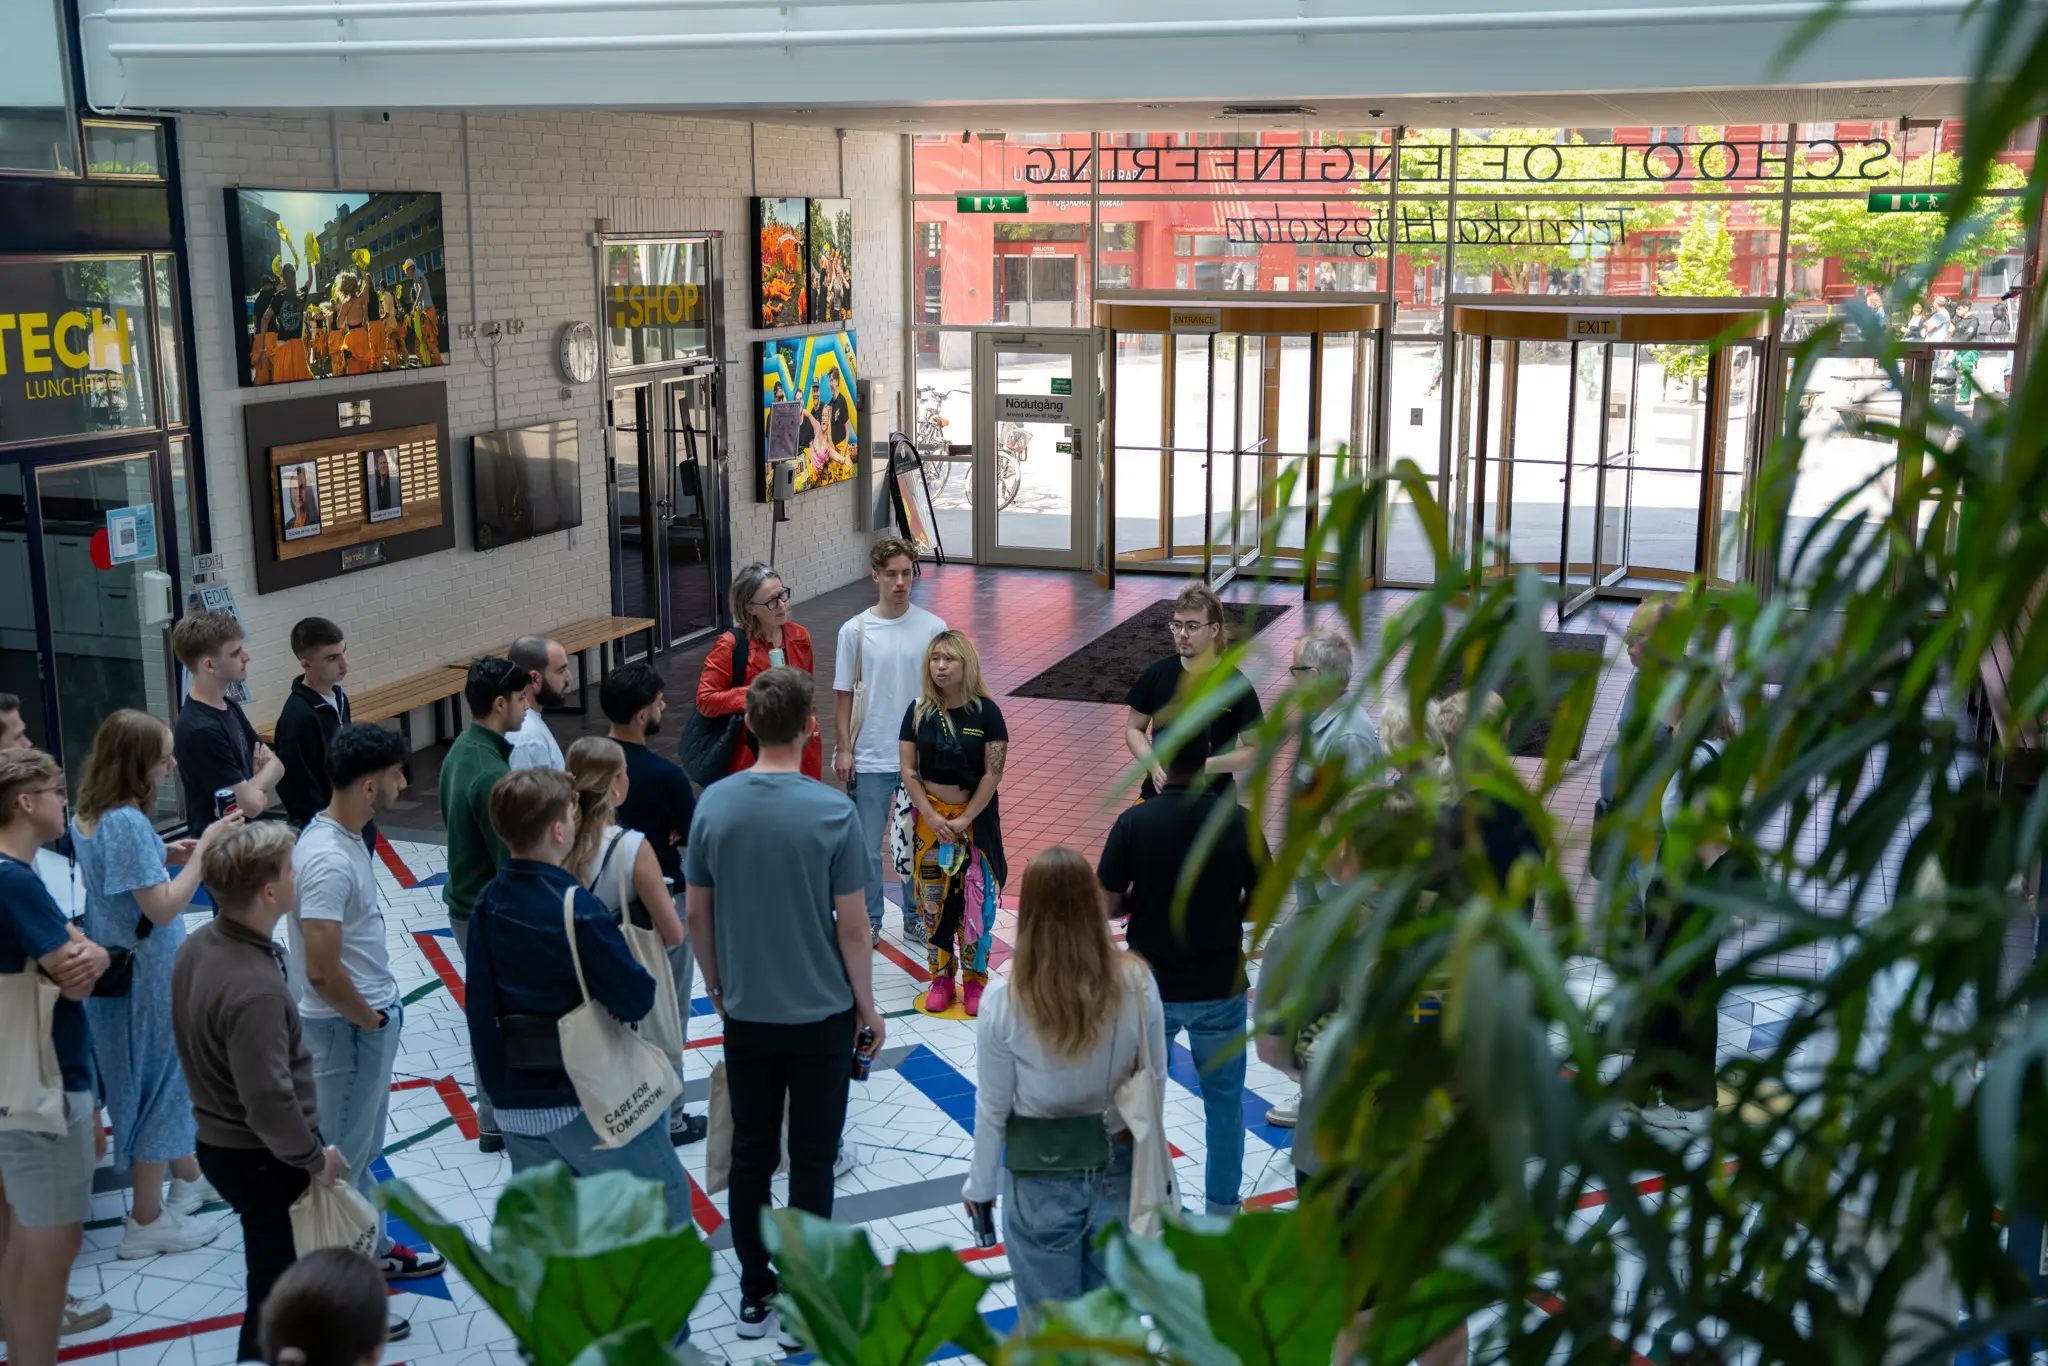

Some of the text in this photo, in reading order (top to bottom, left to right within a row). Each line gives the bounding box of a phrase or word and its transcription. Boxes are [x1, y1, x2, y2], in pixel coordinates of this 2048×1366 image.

[1013, 166, 1093, 182] UNIVERITY
[1172, 316, 1215, 325] ENTRANCE
[1577, 320, 1611, 335] EXIT
[25, 372, 134, 400] LUNCHROOM
[1005, 397, 1064, 413] Nödutgång
[603, 1081, 650, 1125] CARE FOR
[607, 1085, 666, 1136] TOMORROW.
